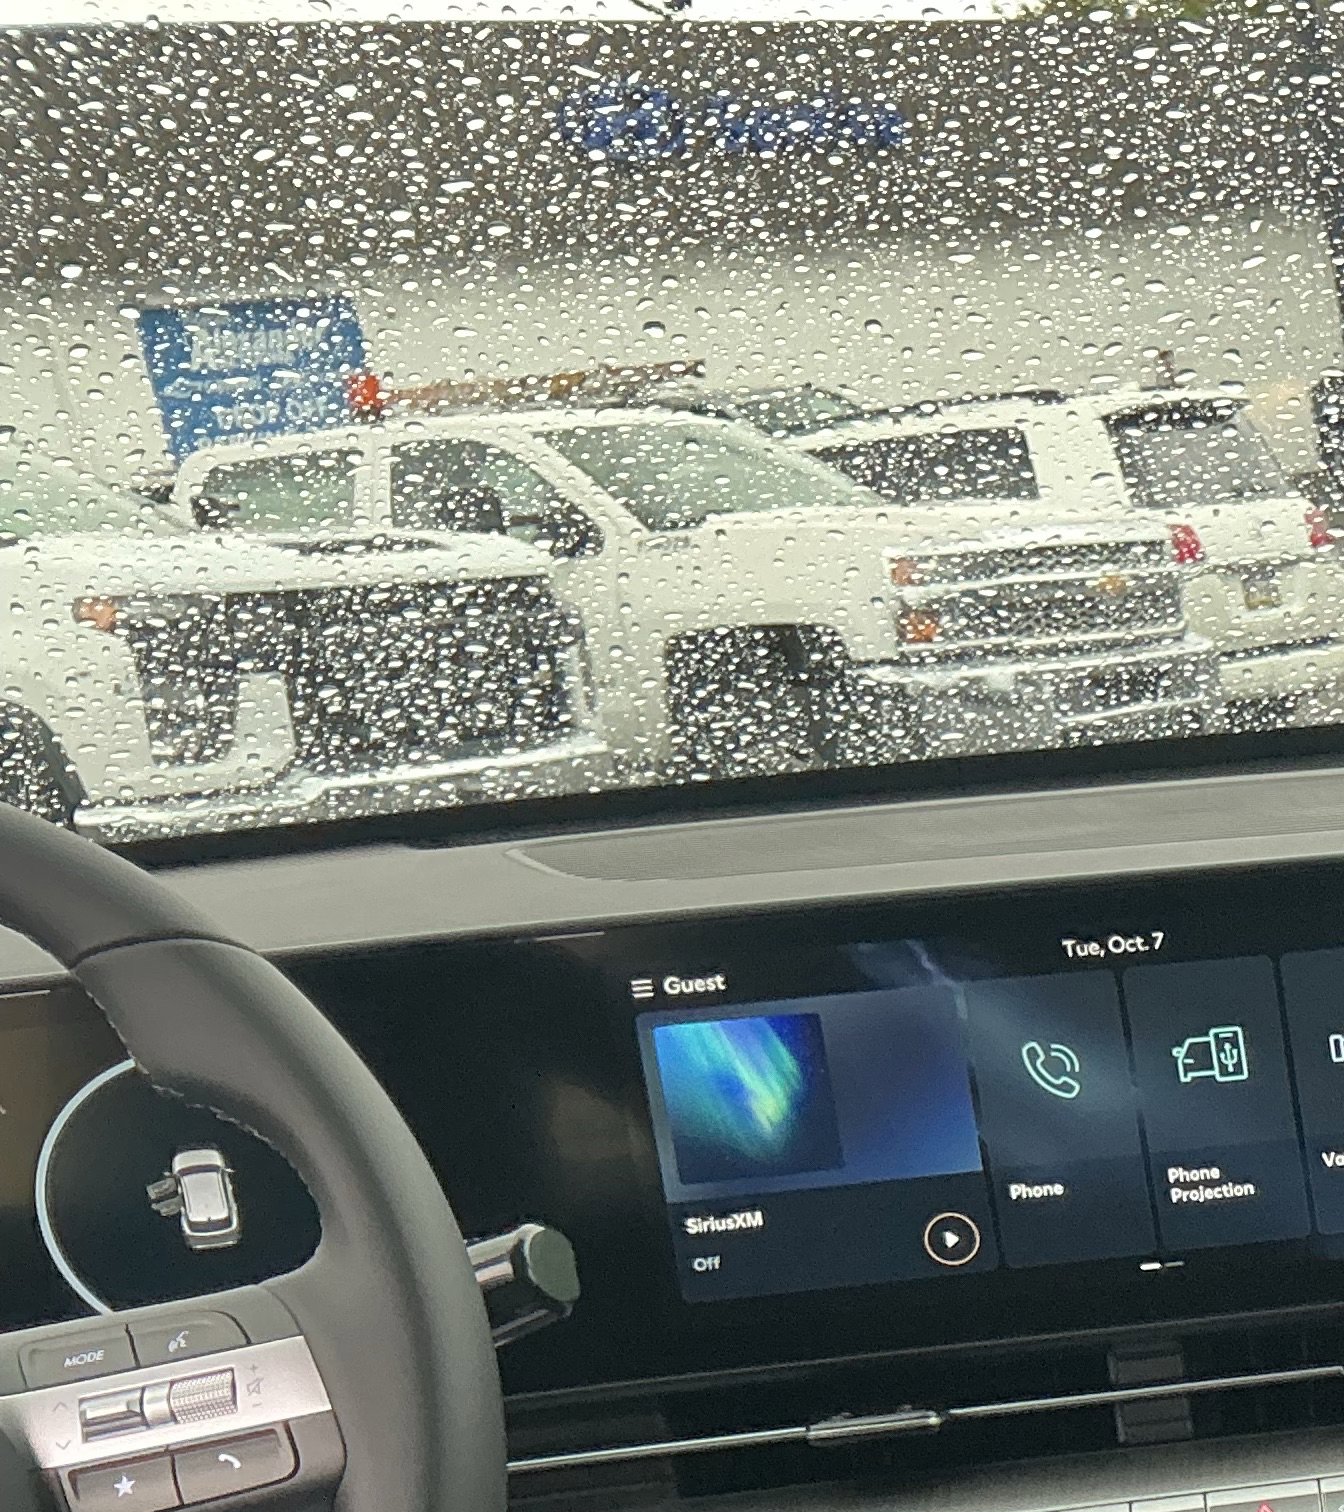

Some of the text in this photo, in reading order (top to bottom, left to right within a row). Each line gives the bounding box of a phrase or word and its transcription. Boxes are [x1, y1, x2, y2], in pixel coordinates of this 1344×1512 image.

[1061, 931, 1164, 958] Tue, Oct. 7
[663, 974, 727, 995] Guest
[1167, 1166, 1220, 1184] Phone
[1008, 1182, 1065, 1200] Phone
[1169, 1182, 1255, 1204] Projection
[685, 1210, 764, 1235] SiriusXM
[693, 1255, 721, 1272] Off
[63, 1350, 105, 1368] MODE
